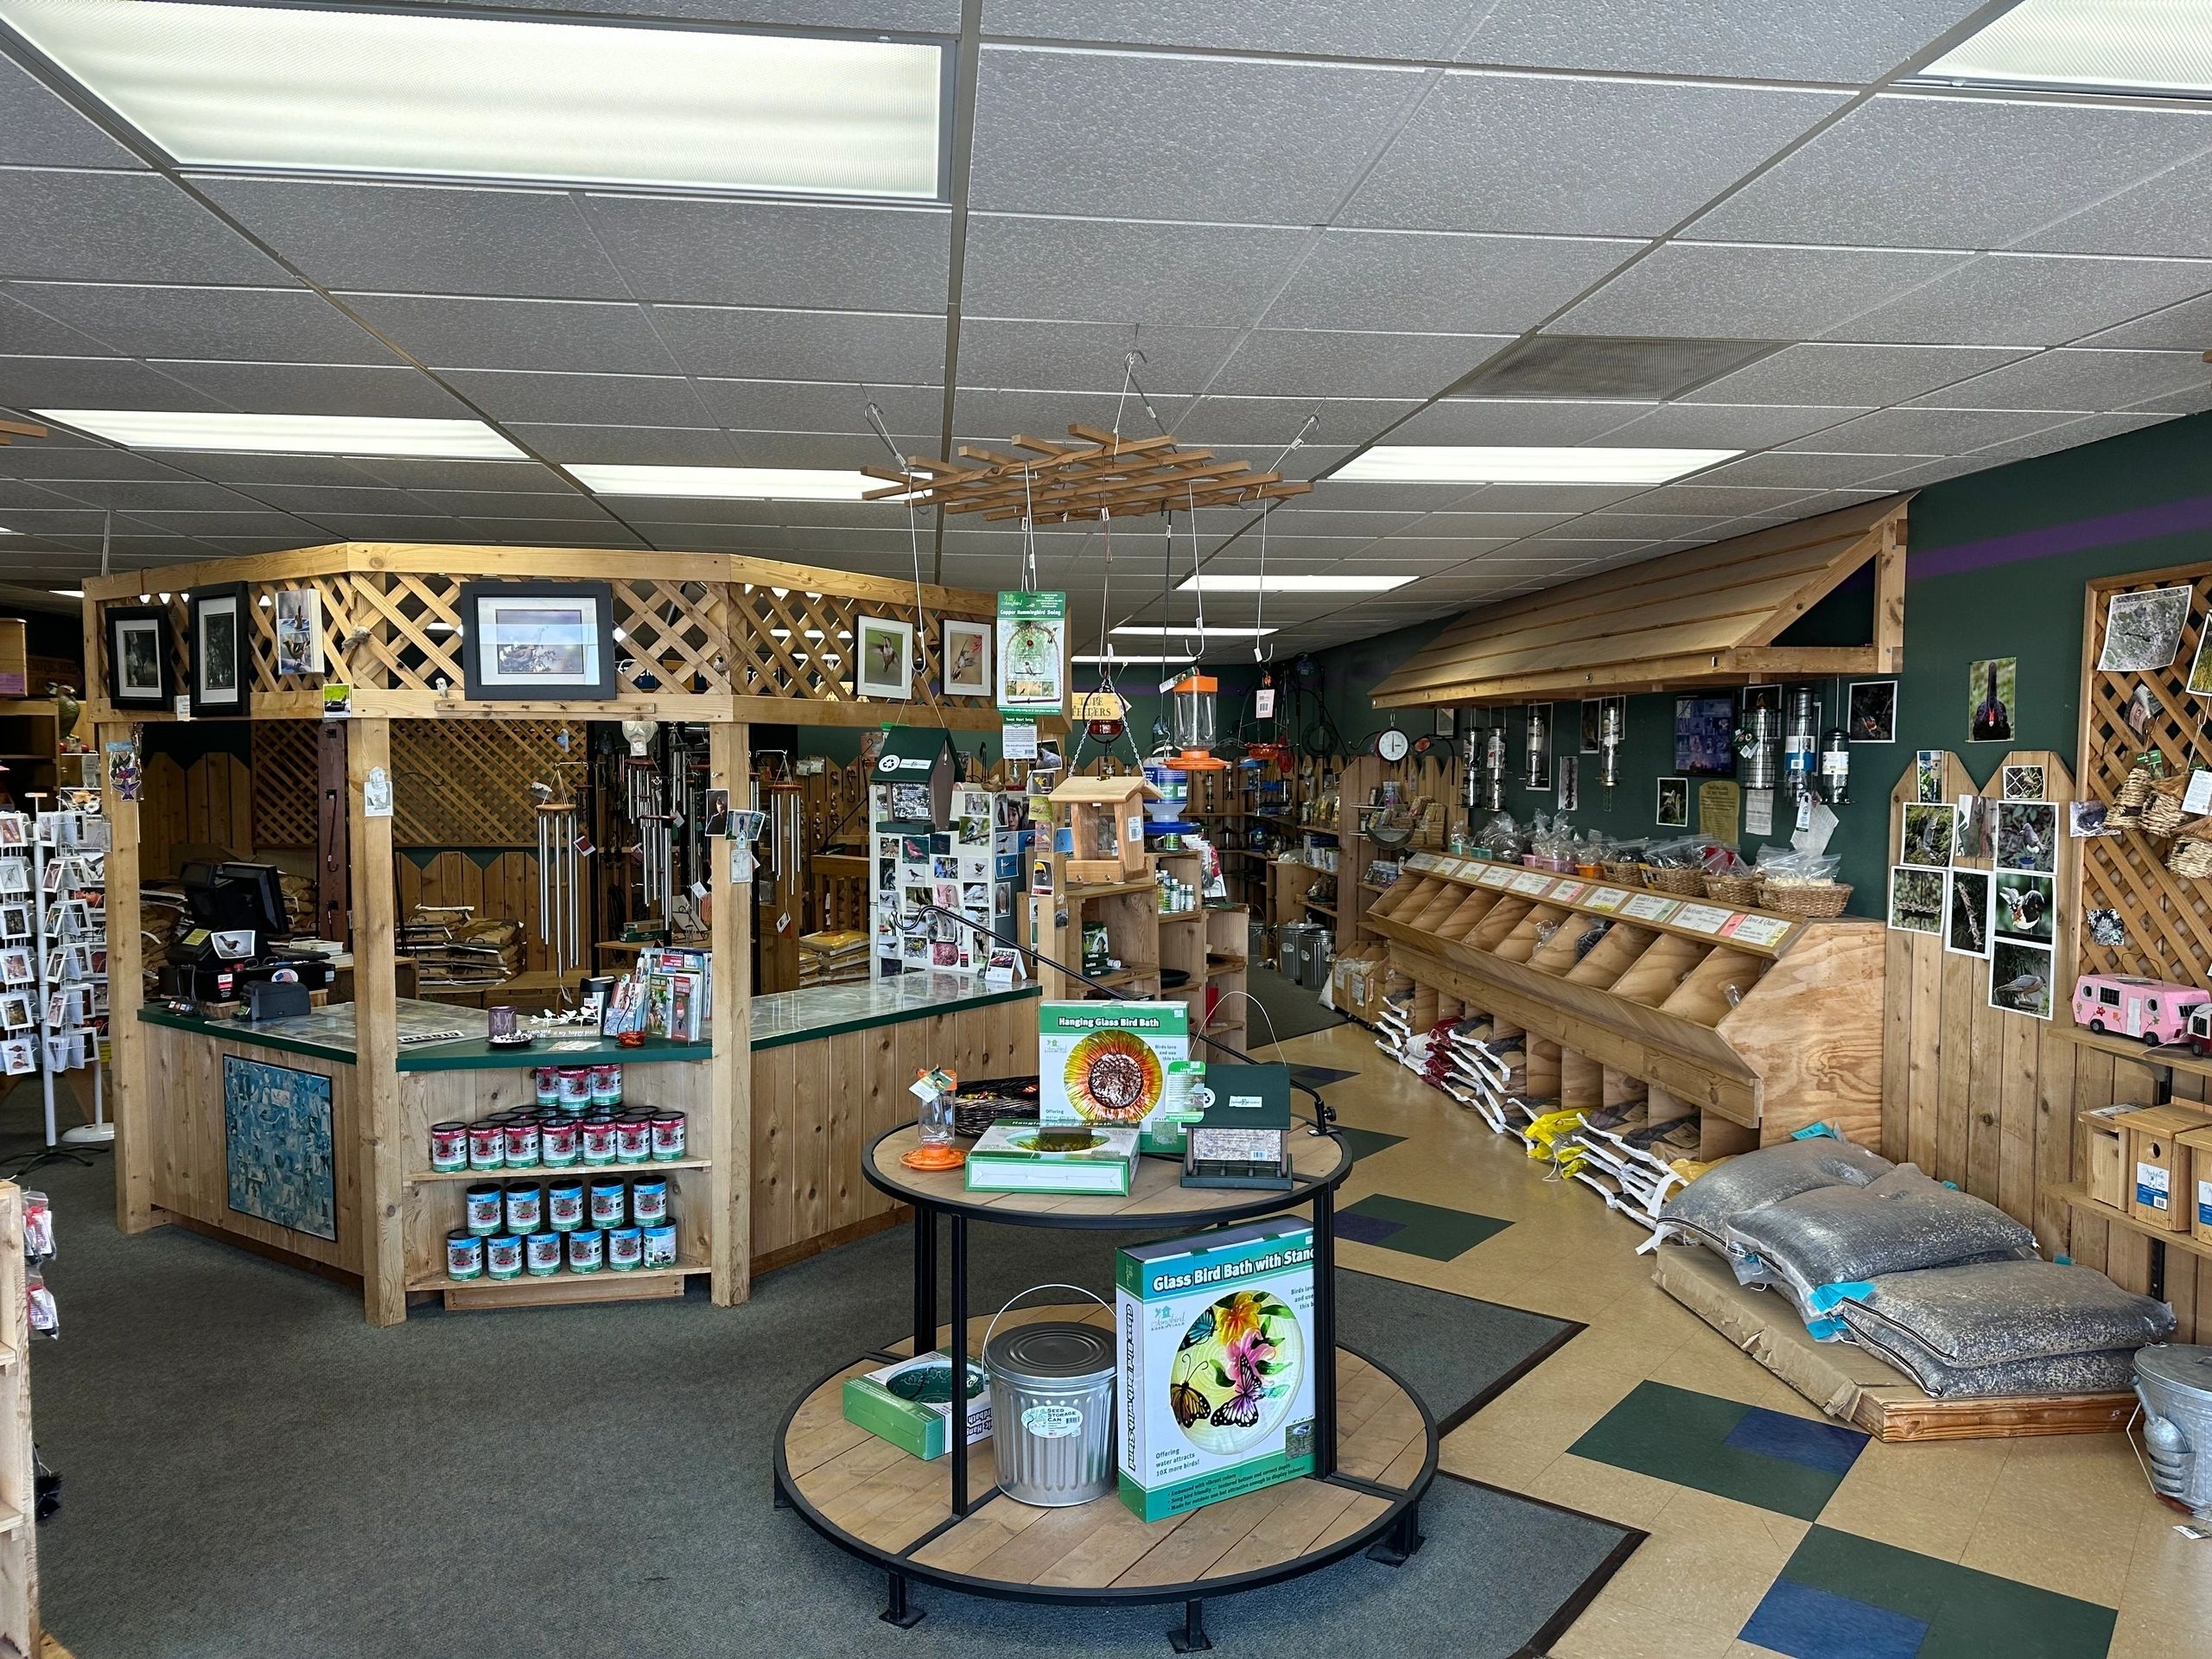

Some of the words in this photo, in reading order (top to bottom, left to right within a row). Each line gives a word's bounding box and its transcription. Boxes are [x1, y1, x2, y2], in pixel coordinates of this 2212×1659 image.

[1059, 1017, 1094, 1028] Hanging
[1095, 1018, 1119, 1027] Glass
[1121, 1018, 1137, 1027] Bird
[1139, 1018, 1159, 1027] Bath
[1154, 1275, 1192, 1293] Glass
[1194, 1267, 1221, 1285] Bird
[1224, 1259, 1253, 1279] Bath
[1255, 1253, 1281, 1272] with
[1291, 1286, 1304, 1294] Birds
[968, 1408, 992, 1425] rdbath
[1127, 1402, 1135, 1431] with
[1128, 1432, 1136, 1471] Stand
[1155, 1447, 1180, 1459] Offering
[1155, 1459, 1172, 1468] water
[1173, 1452, 1196, 1464] attracts
[1156, 1468, 1167, 1477] 10X
[1167, 1465, 1182, 1474] more
[1183, 1459, 1200, 1470] birds!
[1171, 1495, 1183, 1504] Song
[1184, 1491, 1192, 1500] bird
[1194, 1487, 1211, 1497] friendly
[1237, 1476, 1253, 1484] bottom
[1262, 1466, 1277, 1476] correct
[1278, 1463, 1290, 1472] depth
[1171, 1485, 1194, 1497] Embossed
[1195, 1481, 1205, 1490] with
[1205, 1478, 1221, 1487] vibrant
[1171, 1502, 1184, 1510] Made
[1192, 1495, 1210, 1504] outdoor
[1228, 1483, 1249, 1494] attractive
[1249, 1478, 1265, 1488] enough
[1271, 1471, 1287, 1482] display
